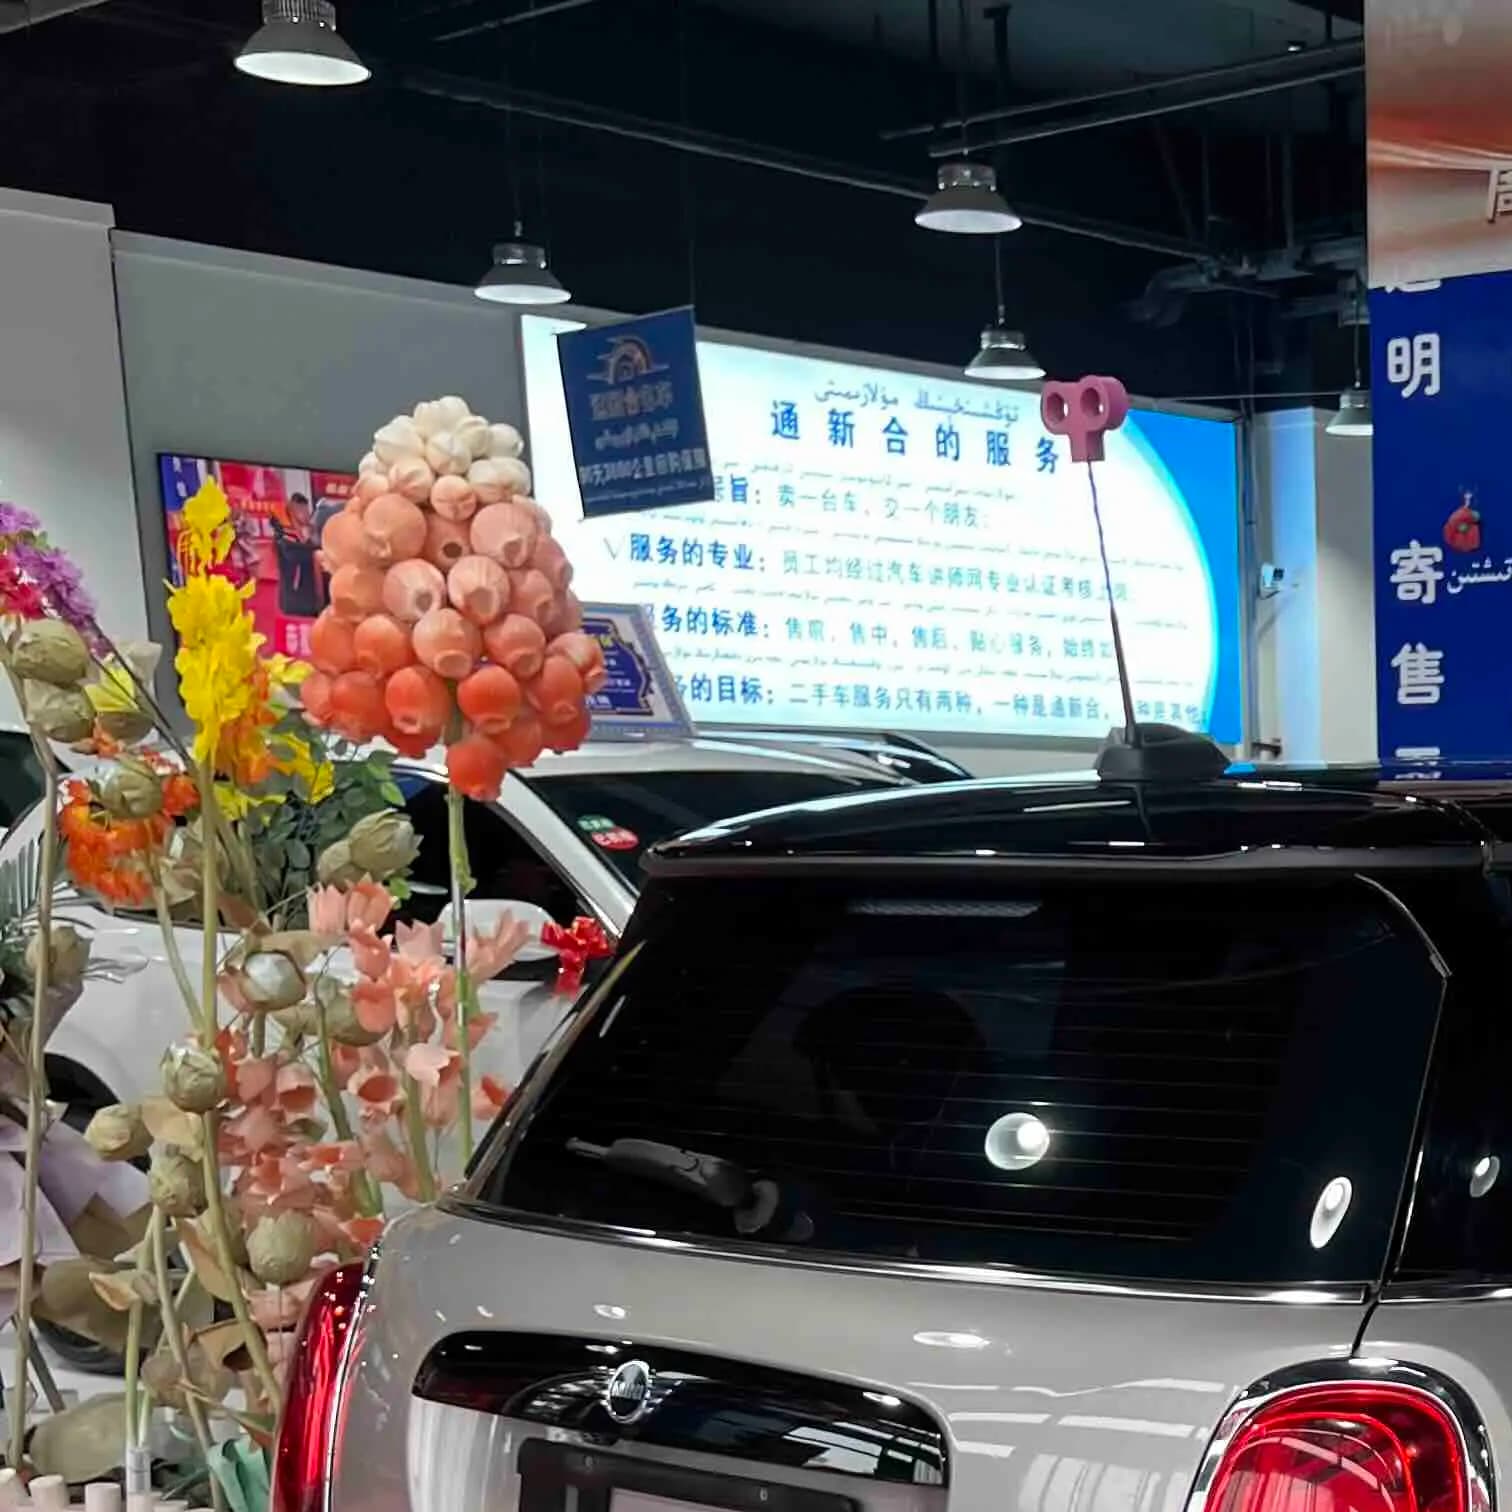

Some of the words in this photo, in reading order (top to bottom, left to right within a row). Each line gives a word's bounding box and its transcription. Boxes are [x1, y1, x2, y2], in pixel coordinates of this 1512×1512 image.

[771, 399, 1061, 475] 通新合的服务
